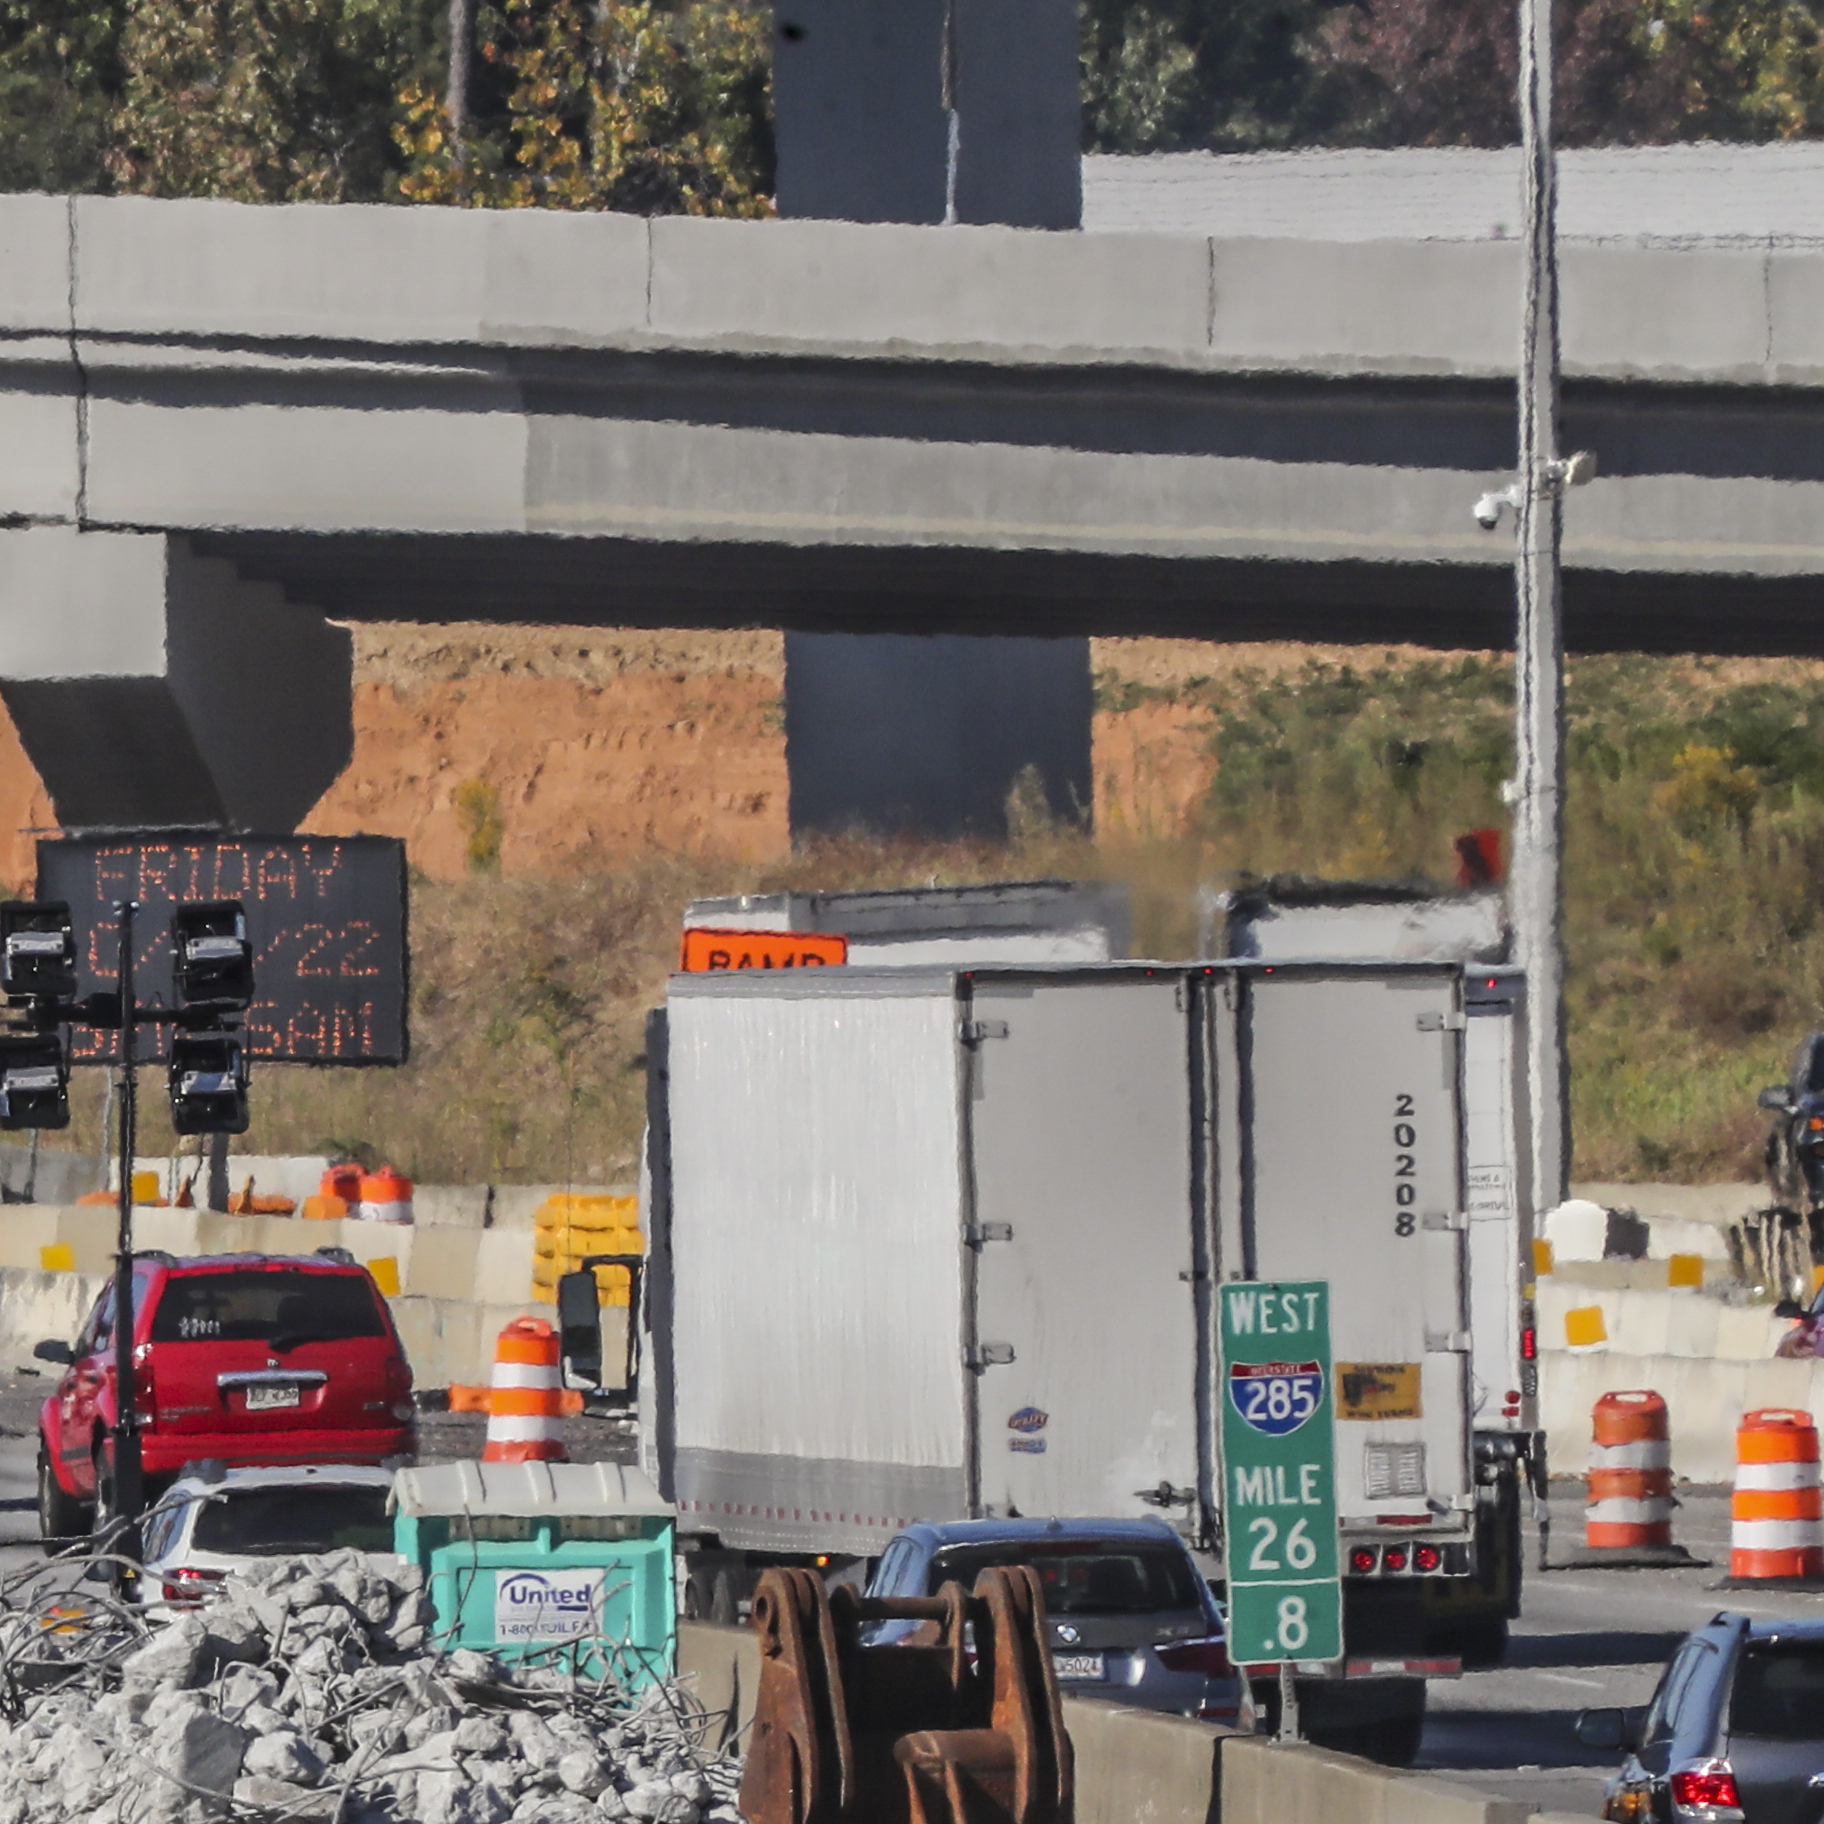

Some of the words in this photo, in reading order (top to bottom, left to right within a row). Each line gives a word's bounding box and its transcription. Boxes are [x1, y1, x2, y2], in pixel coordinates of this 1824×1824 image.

[97, 844, 343, 901] FRIDAY
[1394, 1093, 1416, 1238] 20208
[1229, 1291, 1320, 1335] WEST
[1245, 1378, 1315, 1421] 285
[1235, 1464, 1322, 1506] MILE
[1249, 1516, 1317, 1571] 26
[510, 1584, 591, 1605] United
[1263, 1595, 1309, 1650] .8
